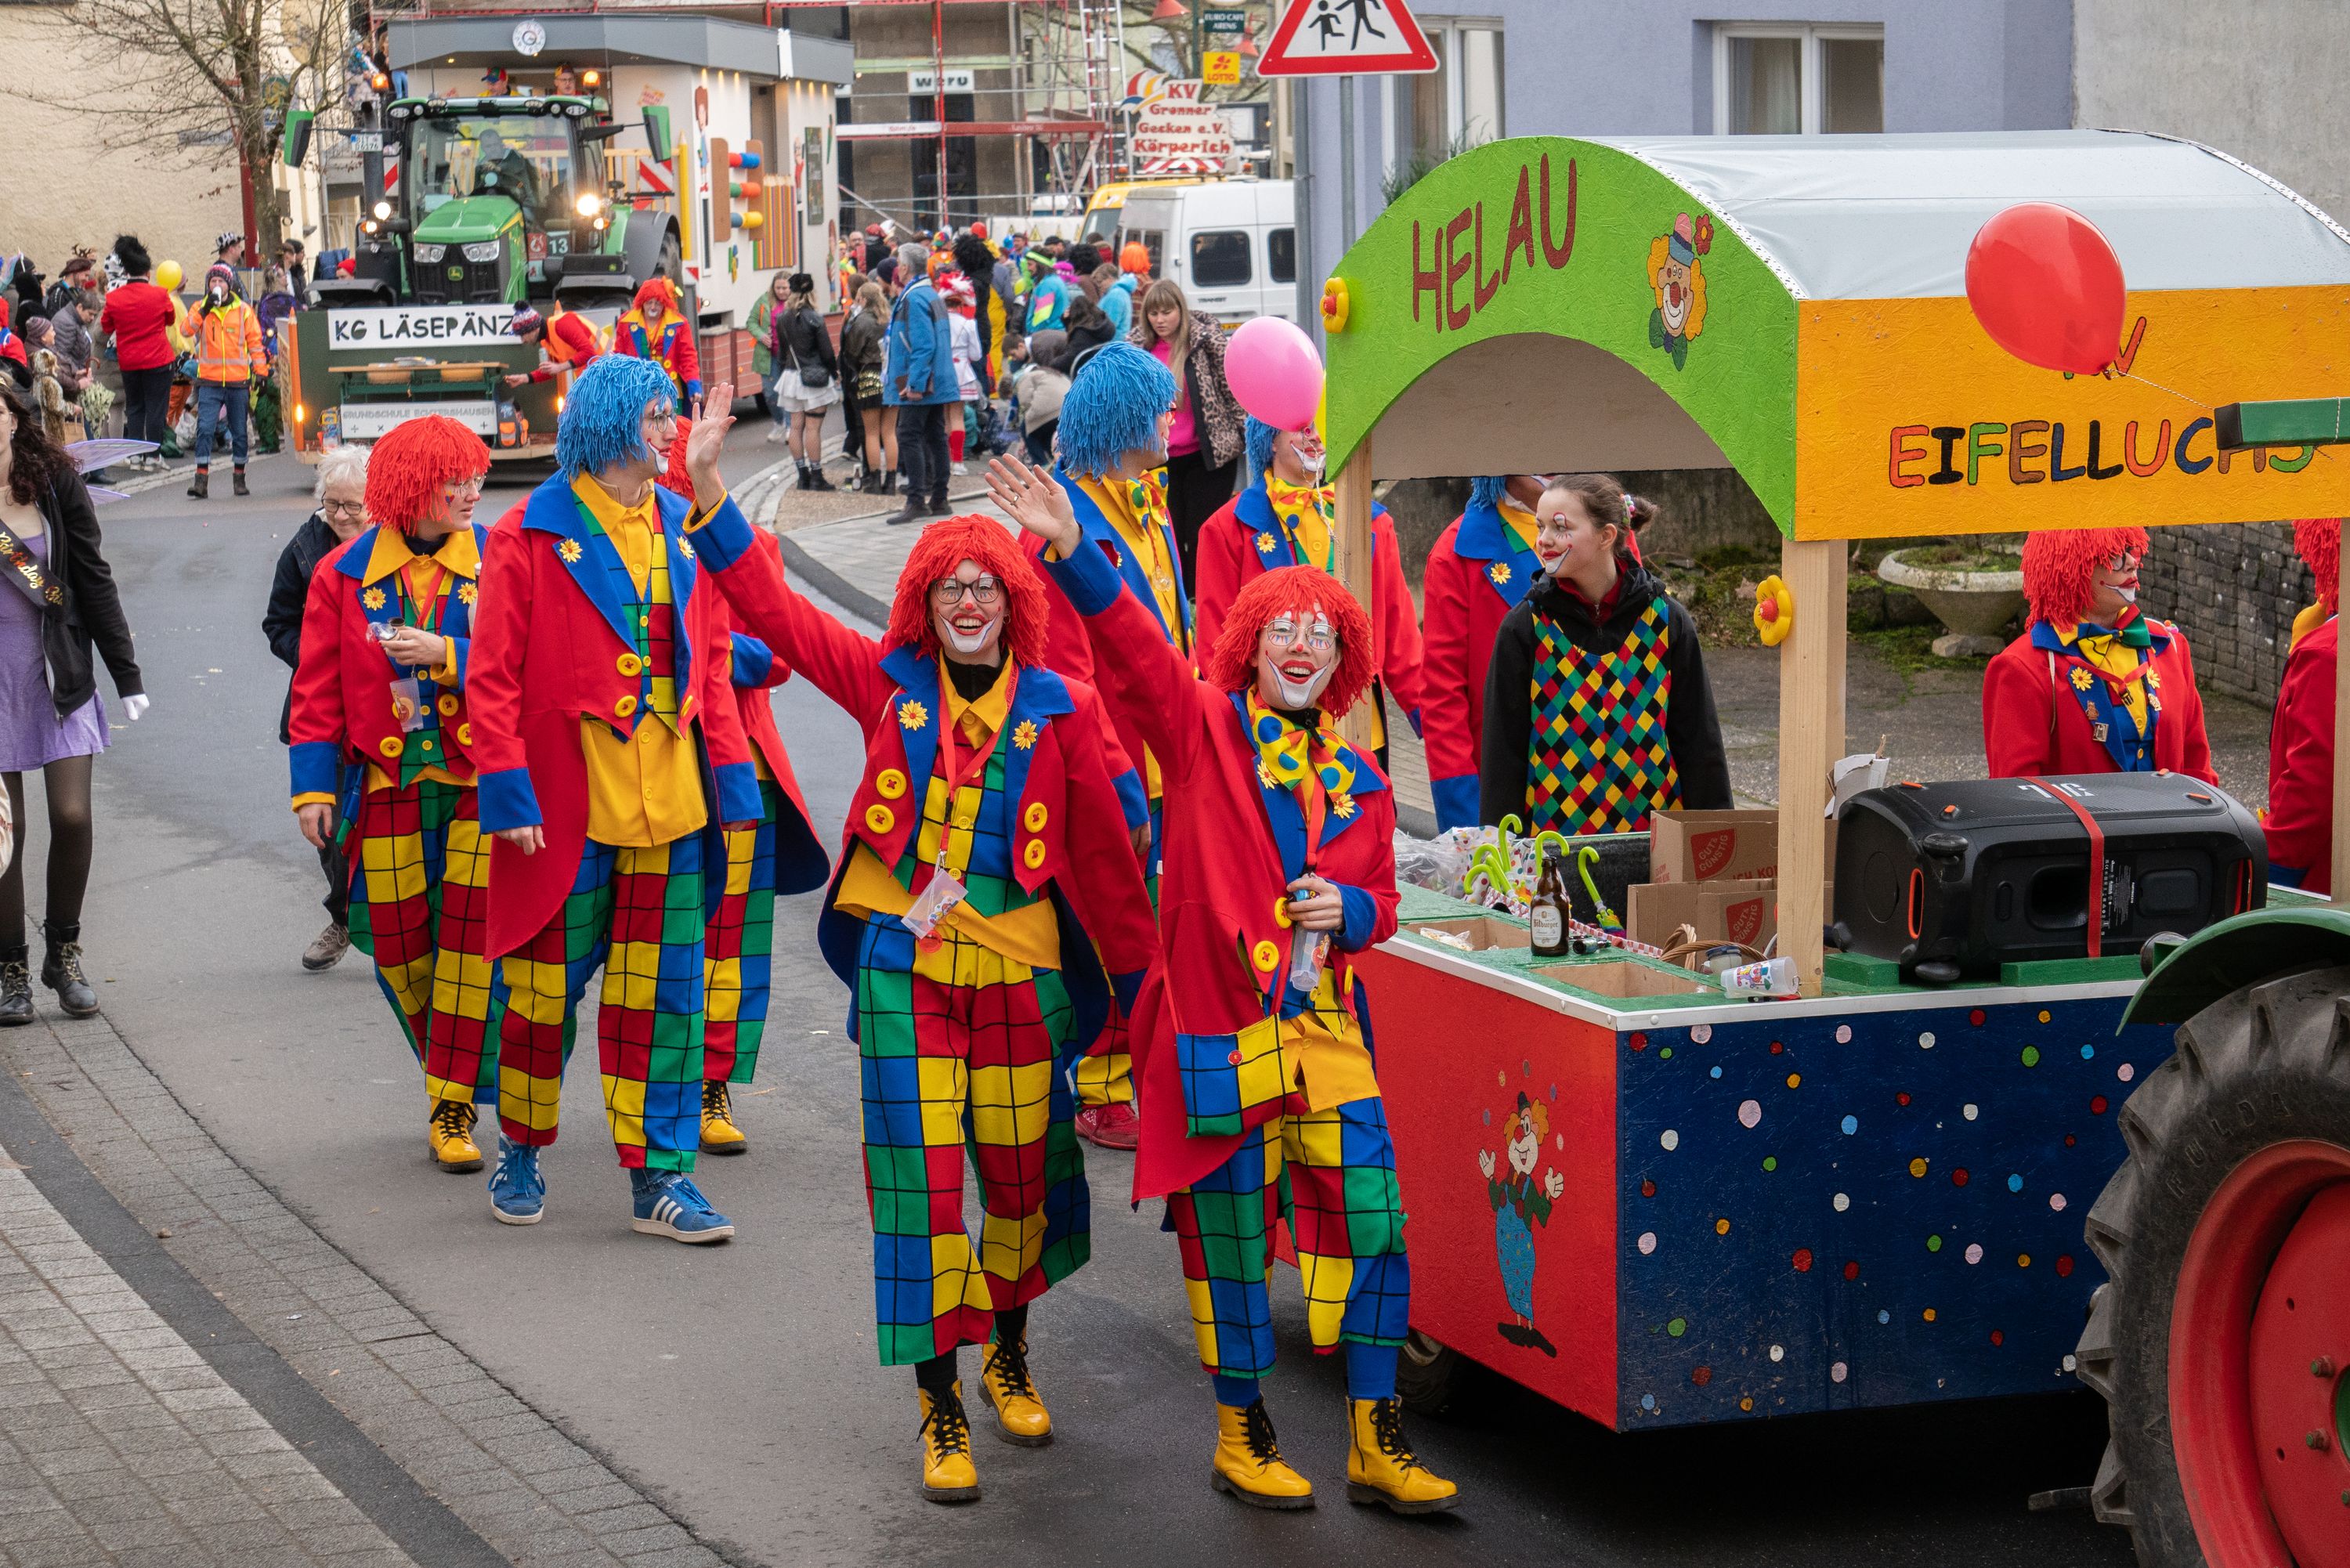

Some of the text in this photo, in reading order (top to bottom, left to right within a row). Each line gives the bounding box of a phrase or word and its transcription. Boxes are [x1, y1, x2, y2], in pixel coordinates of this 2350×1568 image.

[1207, 73, 1236, 81] LOTTO
[1168, 84, 1197, 99] KV
[1138, 122, 1227, 134] Gecken e.V.
[1133, 138, 1231, 156] Körperich
[549, 237, 569, 255] 13
[1412, 153, 1578, 334] HELAU
[334, 312, 515, 341] KG LÄSEPÄNZ
[2164, 1092, 2293, 1200] FULDA
